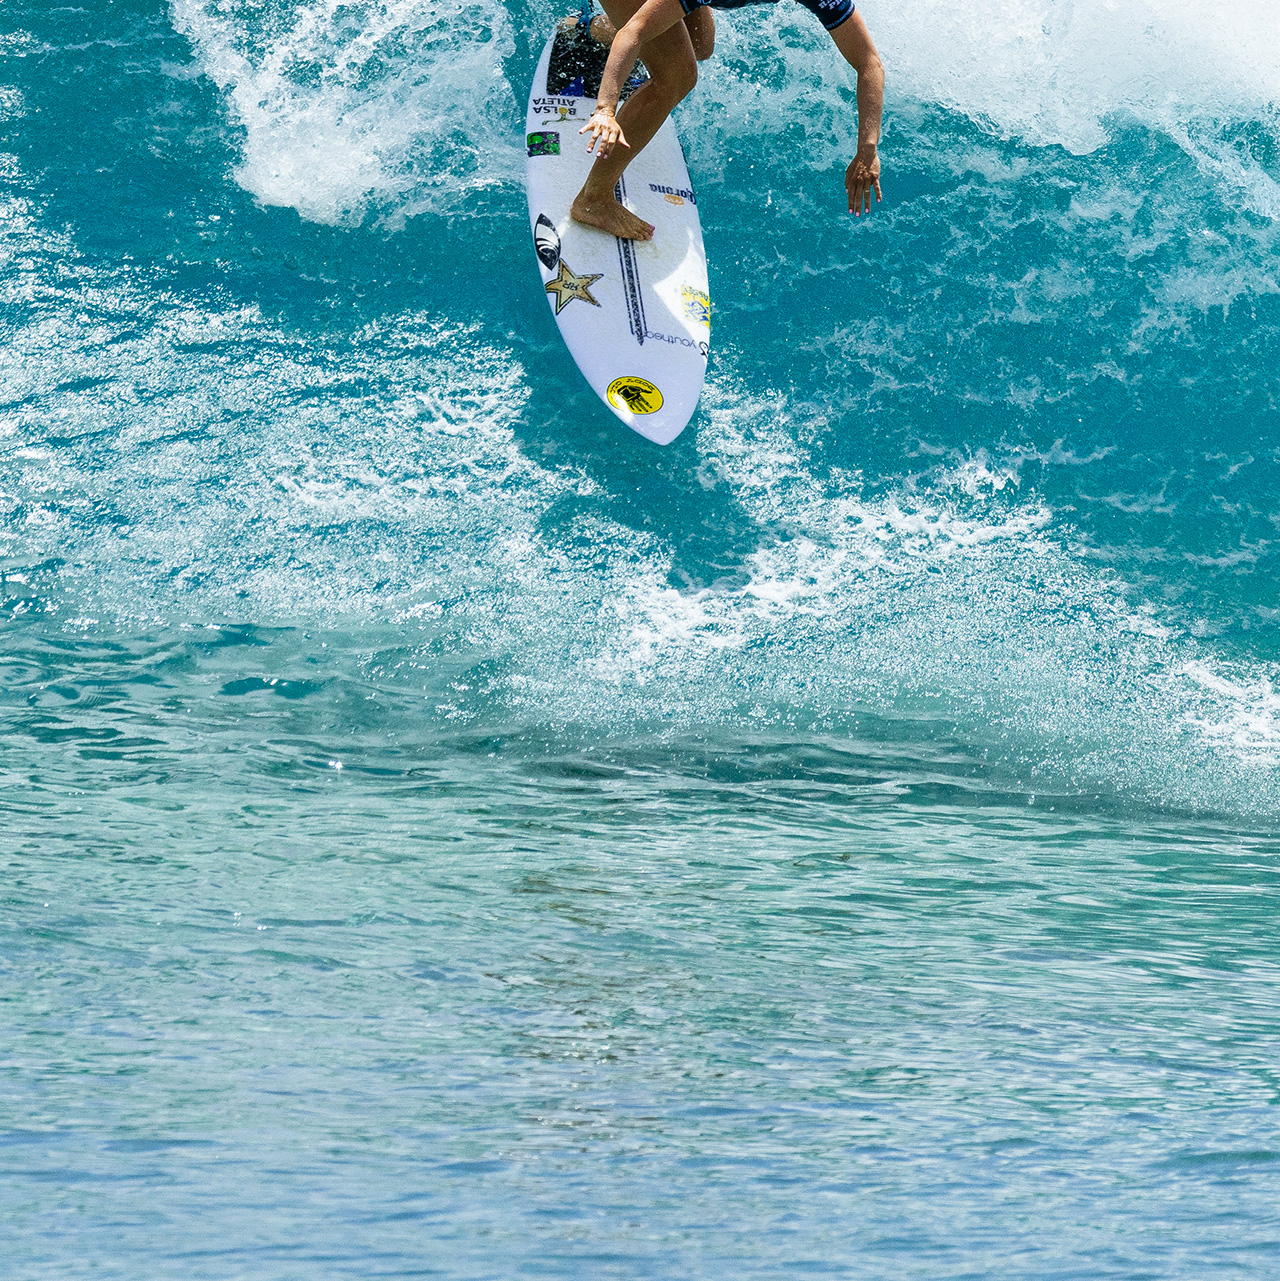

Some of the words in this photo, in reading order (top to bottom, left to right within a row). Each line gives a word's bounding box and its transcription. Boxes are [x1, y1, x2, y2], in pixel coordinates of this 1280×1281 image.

[532, 97, 576, 107] ATLETA
[532, 106, 577, 116] BOLSA
[648, 183, 697, 206] Corona
